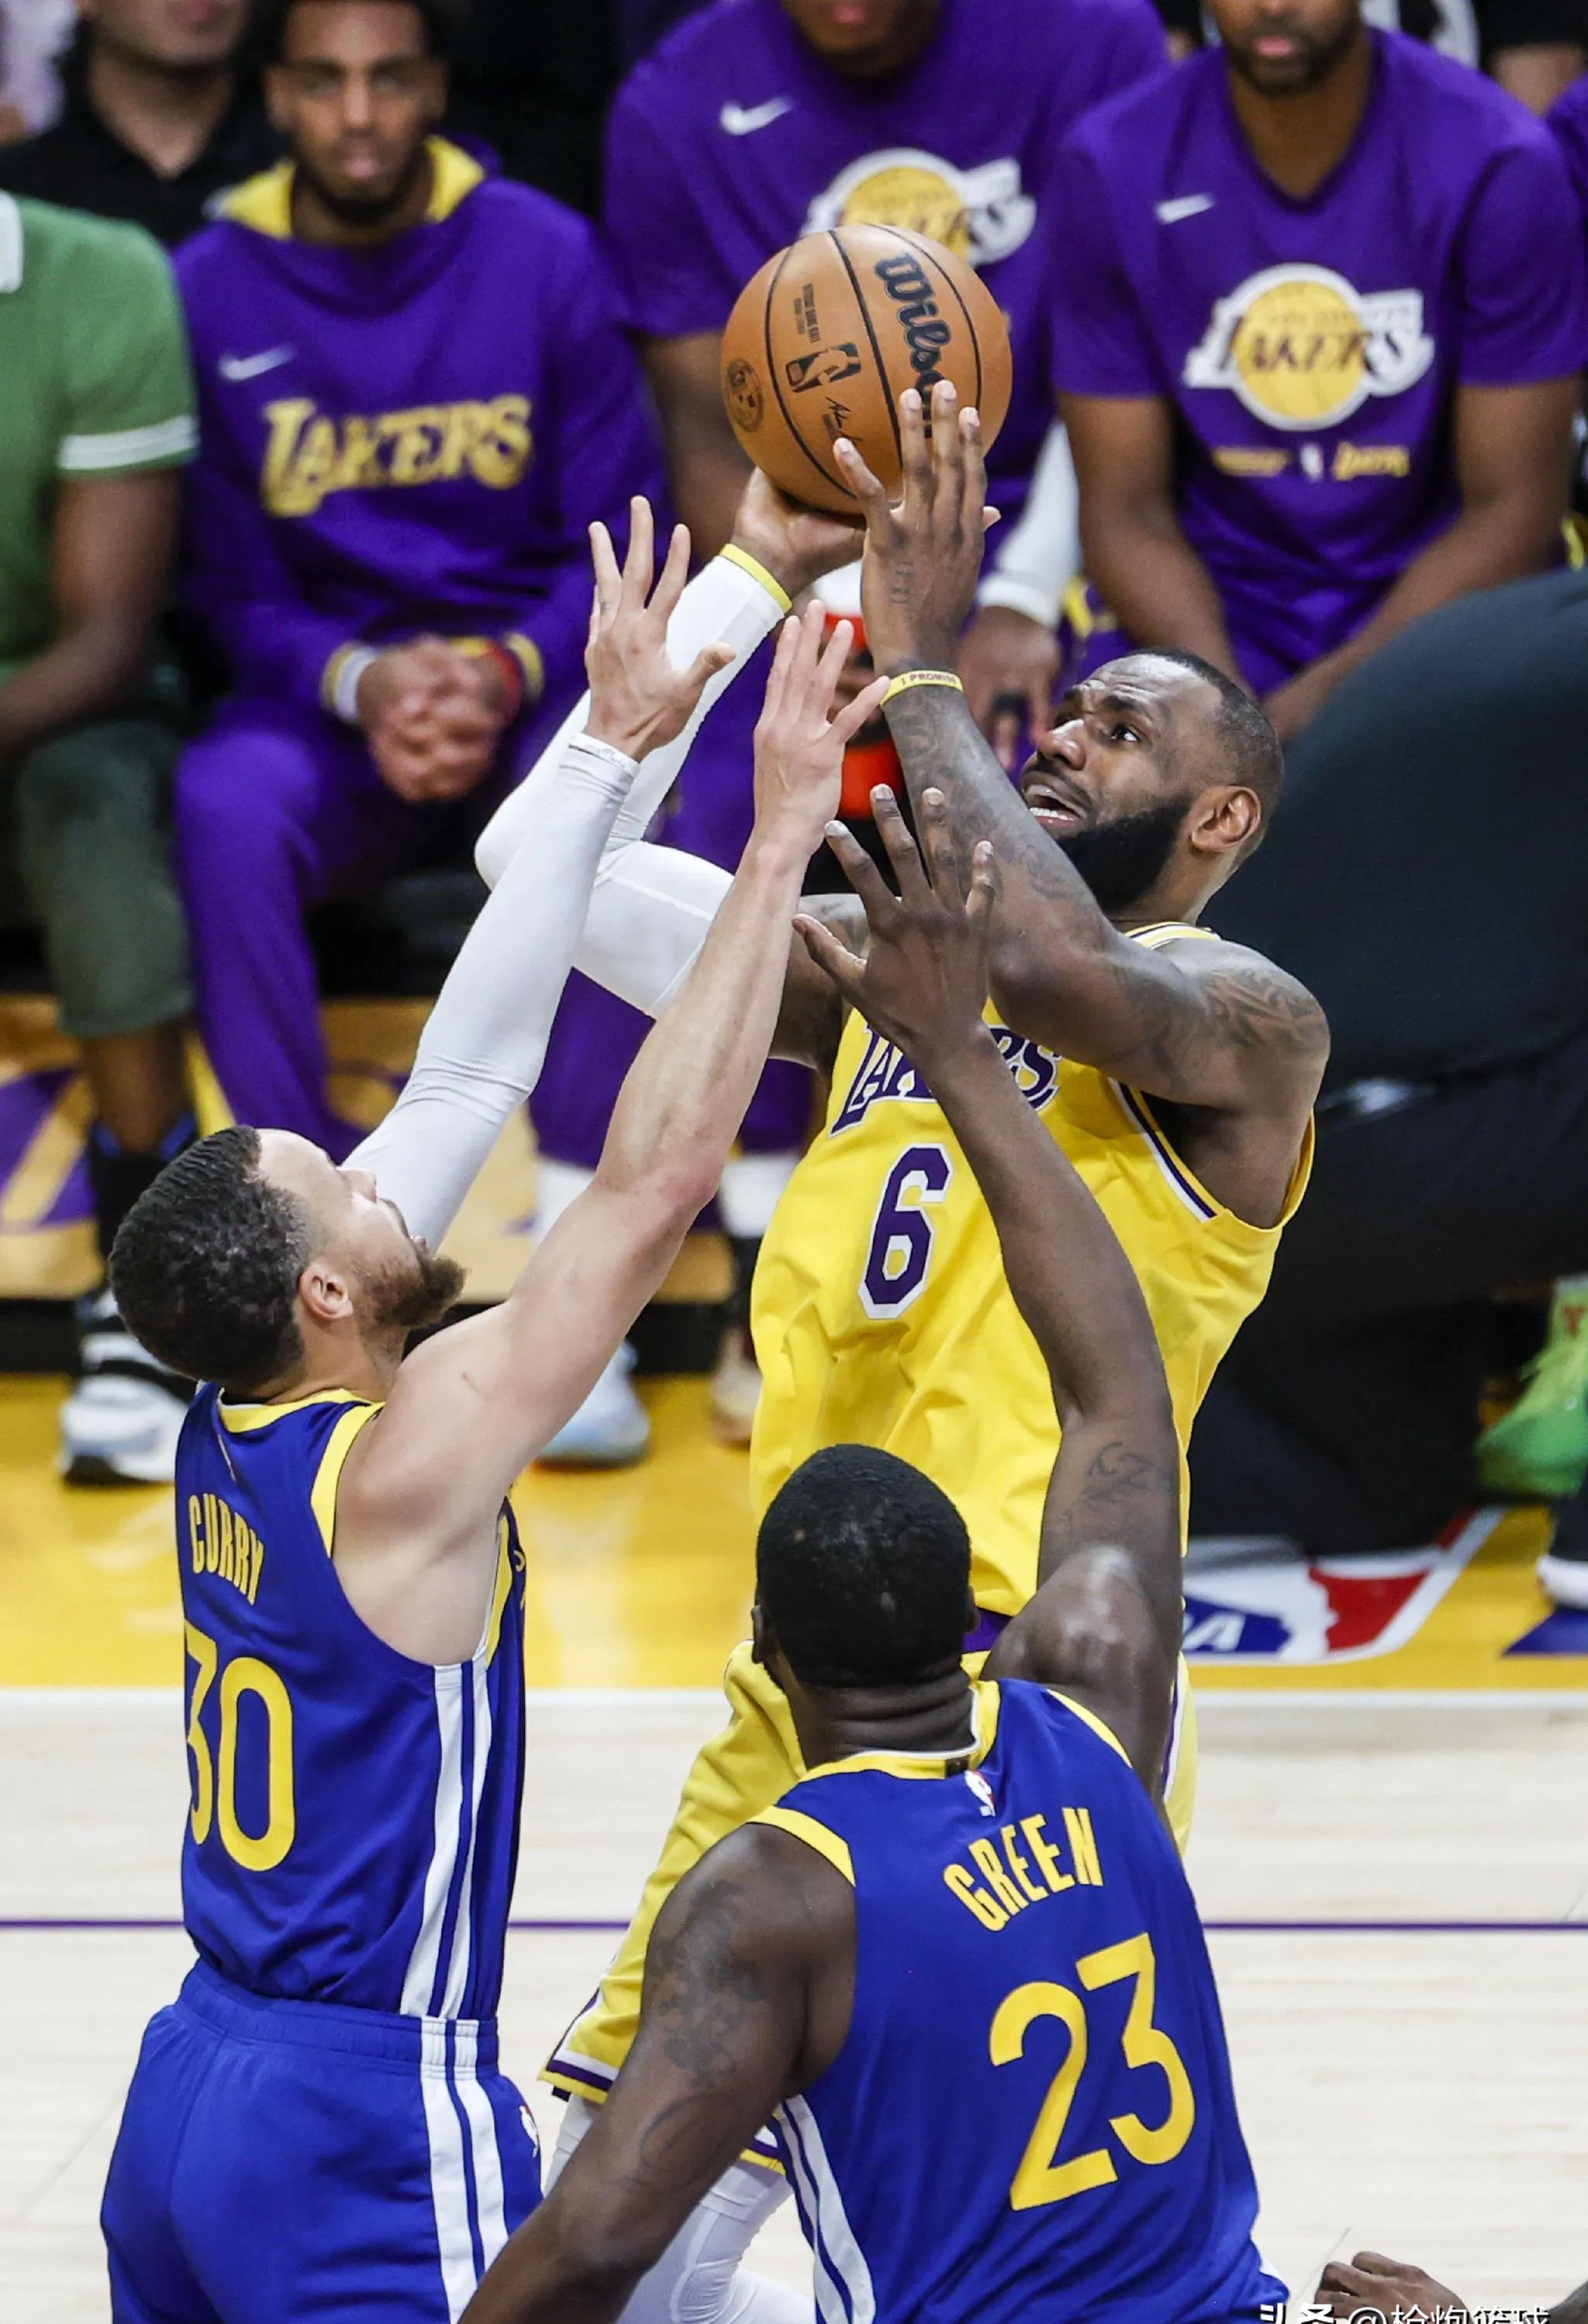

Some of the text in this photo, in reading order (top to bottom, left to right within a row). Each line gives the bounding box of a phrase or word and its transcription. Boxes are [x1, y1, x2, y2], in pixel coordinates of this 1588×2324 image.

[858, 1143, 955, 1320] 6
[188, 1494, 264, 1606] CURRY
[185, 1618, 295, 1872] 30
[943, 1807, 1103, 1932] GREEN
[989, 1932, 1196, 2212] 23
